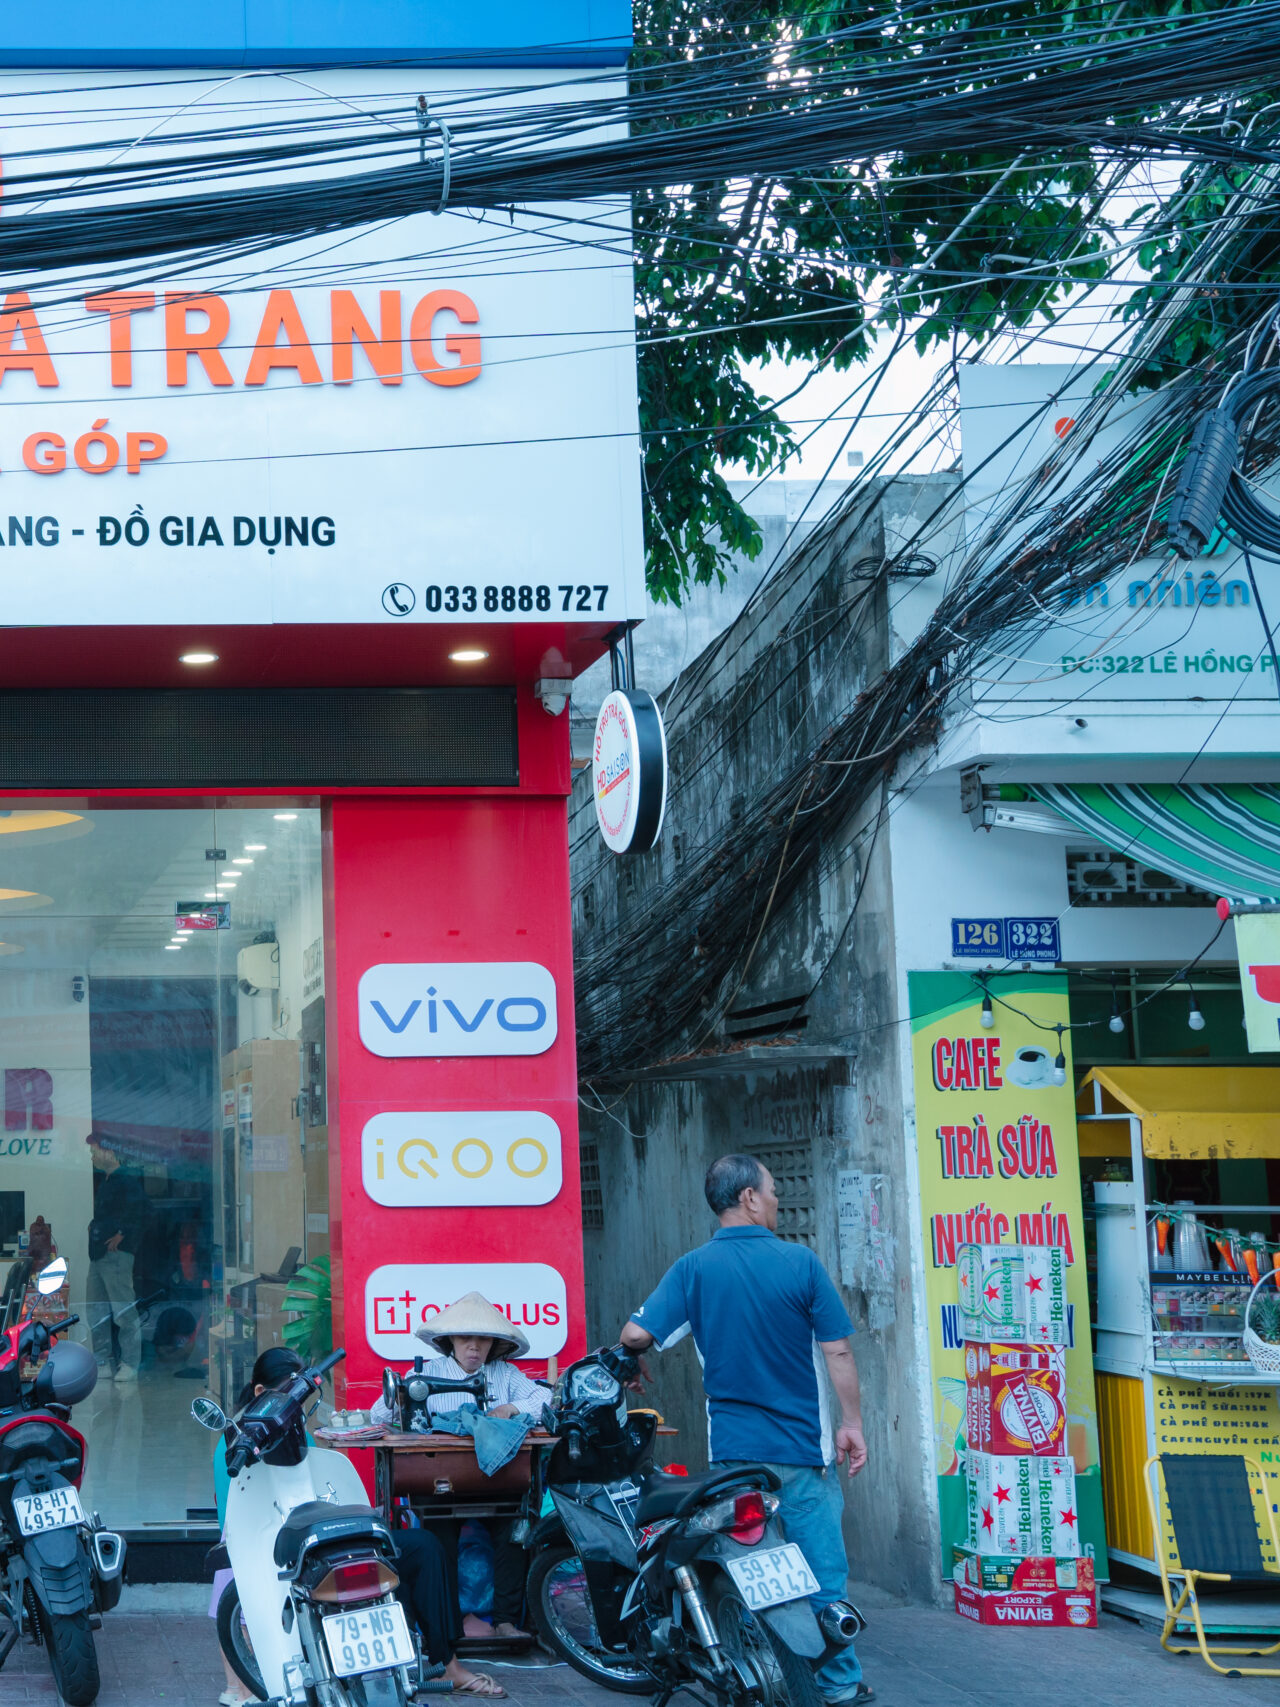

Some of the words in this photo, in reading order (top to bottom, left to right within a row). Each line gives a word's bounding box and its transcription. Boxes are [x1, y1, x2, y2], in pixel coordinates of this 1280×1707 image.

[86, 288, 483, 388] TRANG
[22, 418, 168, 475] GÓP
[96, 504, 150, 547] ĐỒ
[159, 515, 225, 547] GIA
[233, 515, 336, 556] DỤNG
[425, 586, 478, 613] 033
[484, 586, 551, 612] 8888
[558, 585, 609, 612] 727
[1150, 651, 1177, 674] LÊ
[1184, 648, 1254, 674] HỒNG
[956, 923, 999, 946] 126
[1012, 923, 1053, 946] 322
[370, 985, 546, 1034] vivo
[933, 1036, 1003, 1090] CAFE
[376, 1137, 548, 1180] iQOO
[938, 1114, 994, 1177] TRÀ
[999, 1114, 1058, 1177] SỮA
[1001, 1257, 1014, 1326] Heineken
[1049, 1248, 1064, 1322] Heineken
[1013, 1382, 1047, 1445] BIVINA
[1031, 1390, 1050, 1427] EXPORT
[24, 1491, 68, 1514] 78-H1
[1017, 1458, 1032, 1533] Heineken
[24, 1505, 79, 1531] 495.71
[1039, 1479, 1054, 1554] Heineken
[739, 1550, 794, 1581] 59-P1
[745, 1570, 814, 1606] 203.42
[1004, 1596, 1042, 1604] EXPORT
[335, 1609, 394, 1643] 79-N6
[994, 1606, 1054, 1621] BIVINA
[342, 1636, 399, 1670] 9981
